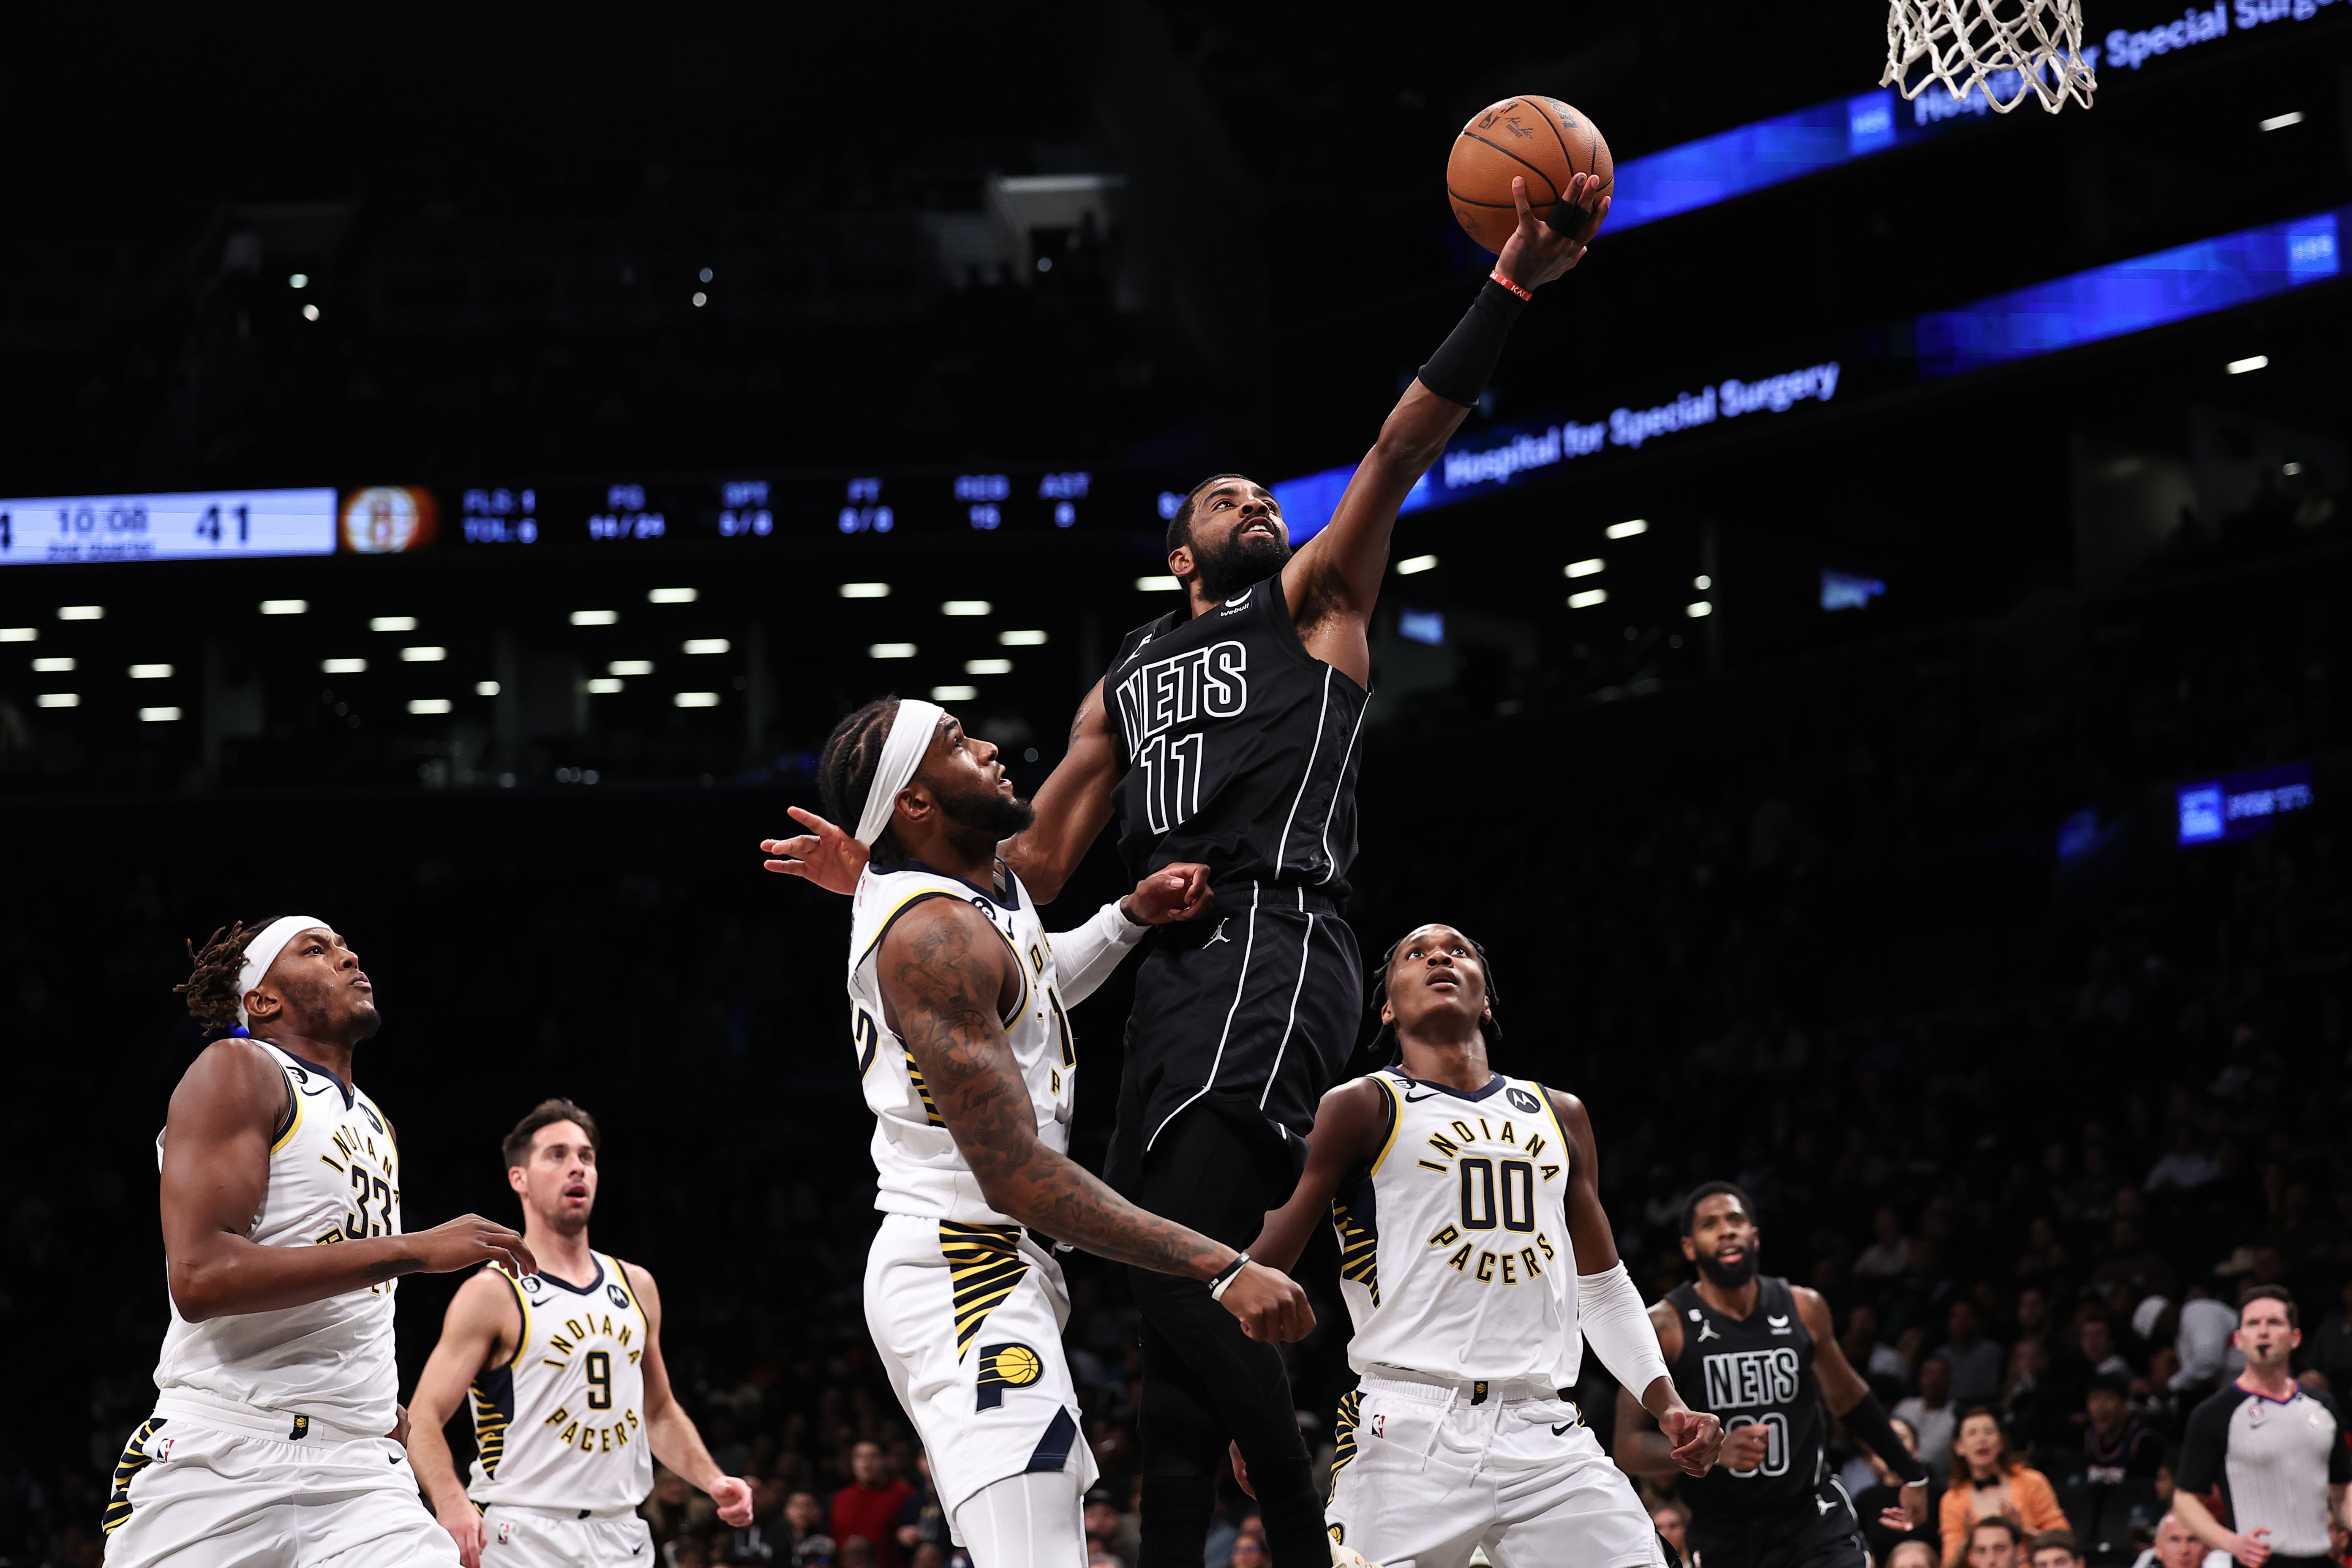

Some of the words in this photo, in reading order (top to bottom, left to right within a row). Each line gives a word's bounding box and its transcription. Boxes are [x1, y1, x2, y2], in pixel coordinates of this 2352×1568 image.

[2105, 0, 2228, 70] Special
[1563, 421, 1604, 458] for
[1609, 386, 1717, 448] Special
[1719, 362, 1840, 417] Surgery
[196, 505, 248, 542] 41
[1116, 641, 1246, 764] NETS
[1140, 732, 1203, 835] 11
[1417, 1118, 1561, 1183] INDIANA
[1458, 1157, 1536, 1234] 00
[1428, 1223, 1555, 1285] PACERS
[542, 1313, 642, 1370] INDIANA
[585, 1350, 612, 1410] 9
[1703, 1347, 1799, 1410] NETS
[544, 1406, 638, 1453] PACERS
